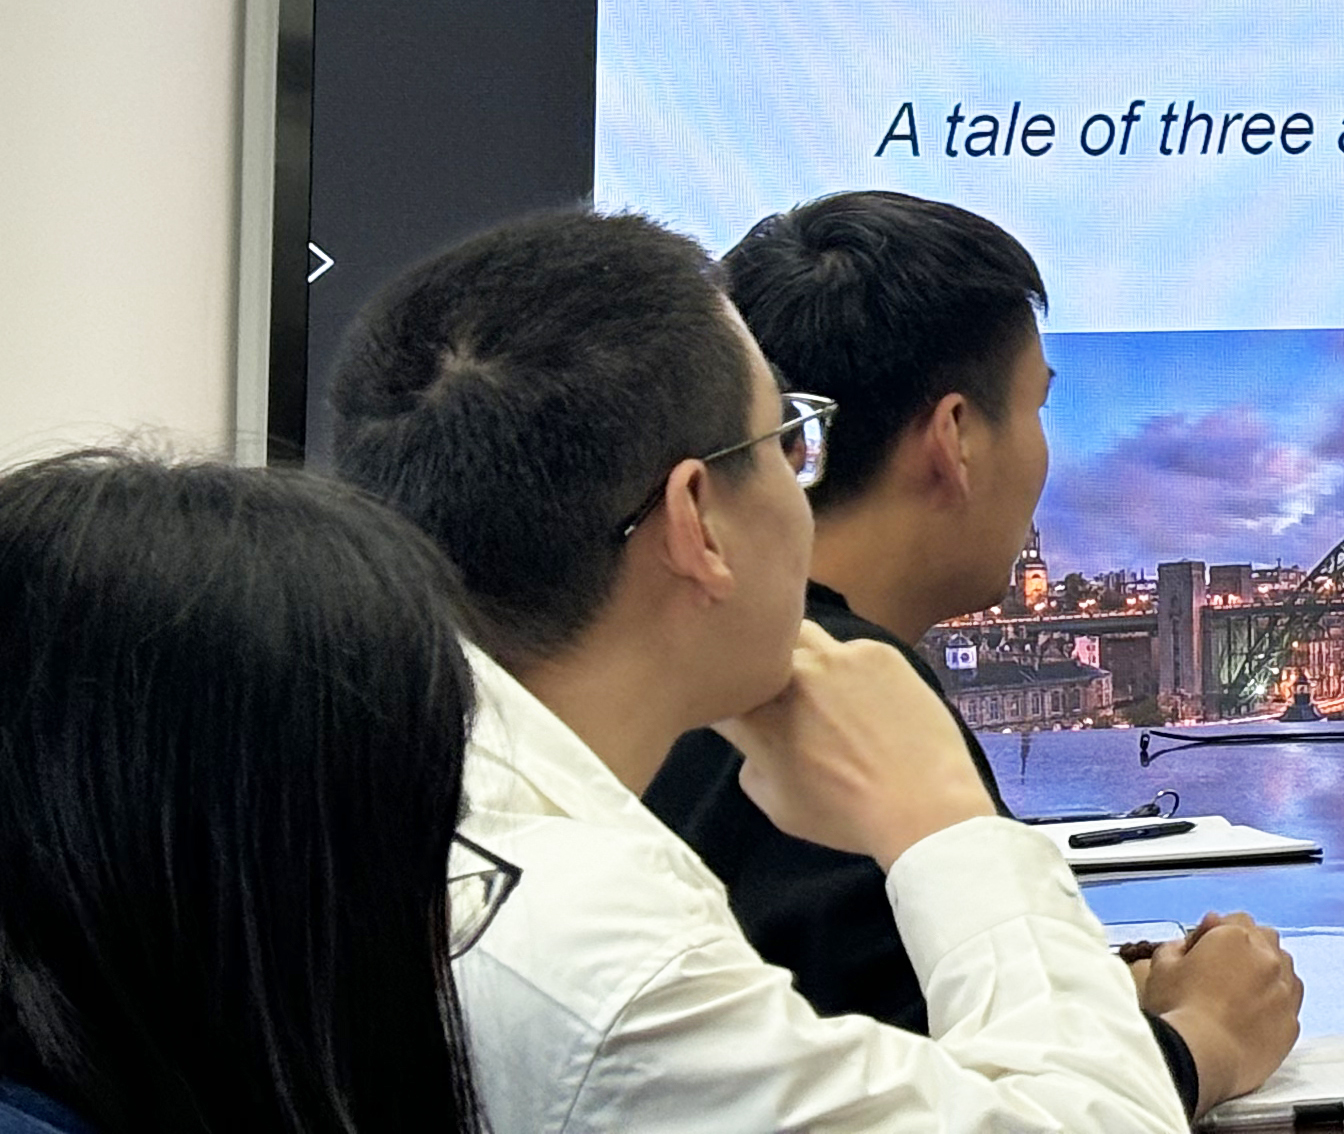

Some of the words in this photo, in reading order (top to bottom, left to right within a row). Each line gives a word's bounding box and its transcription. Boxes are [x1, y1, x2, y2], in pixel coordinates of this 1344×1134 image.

[874, 101, 921, 158] A
[945, 100, 1056, 158] tale
[1080, 99, 1146, 157] of
[1159, 99, 1314, 156] three
